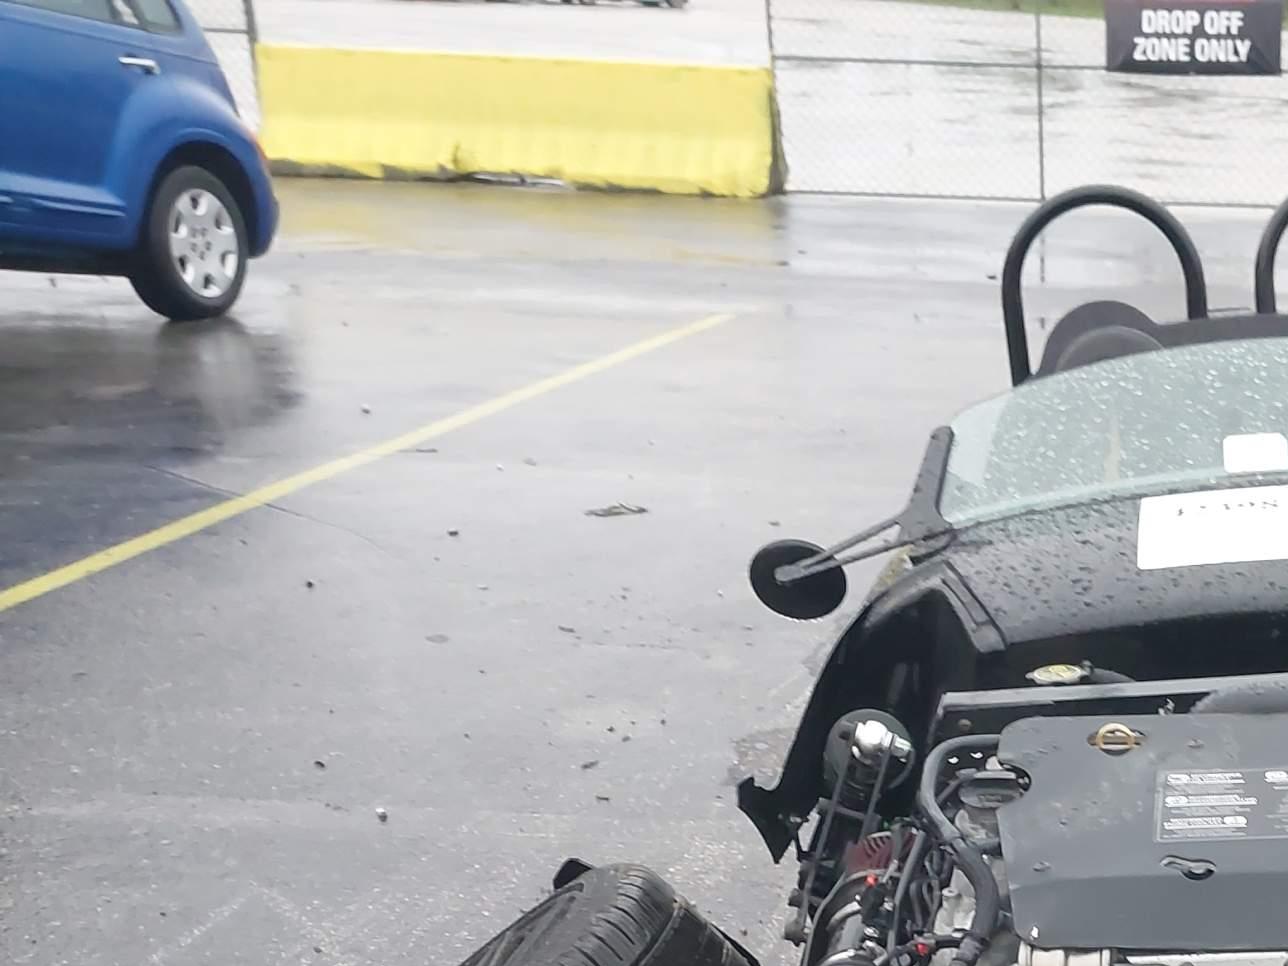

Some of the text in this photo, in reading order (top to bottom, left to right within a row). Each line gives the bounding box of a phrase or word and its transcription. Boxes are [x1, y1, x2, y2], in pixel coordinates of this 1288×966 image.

[1141, 9, 1244, 35] DROP OFF
[1132, 37, 1251, 62] ZONE ONLY
